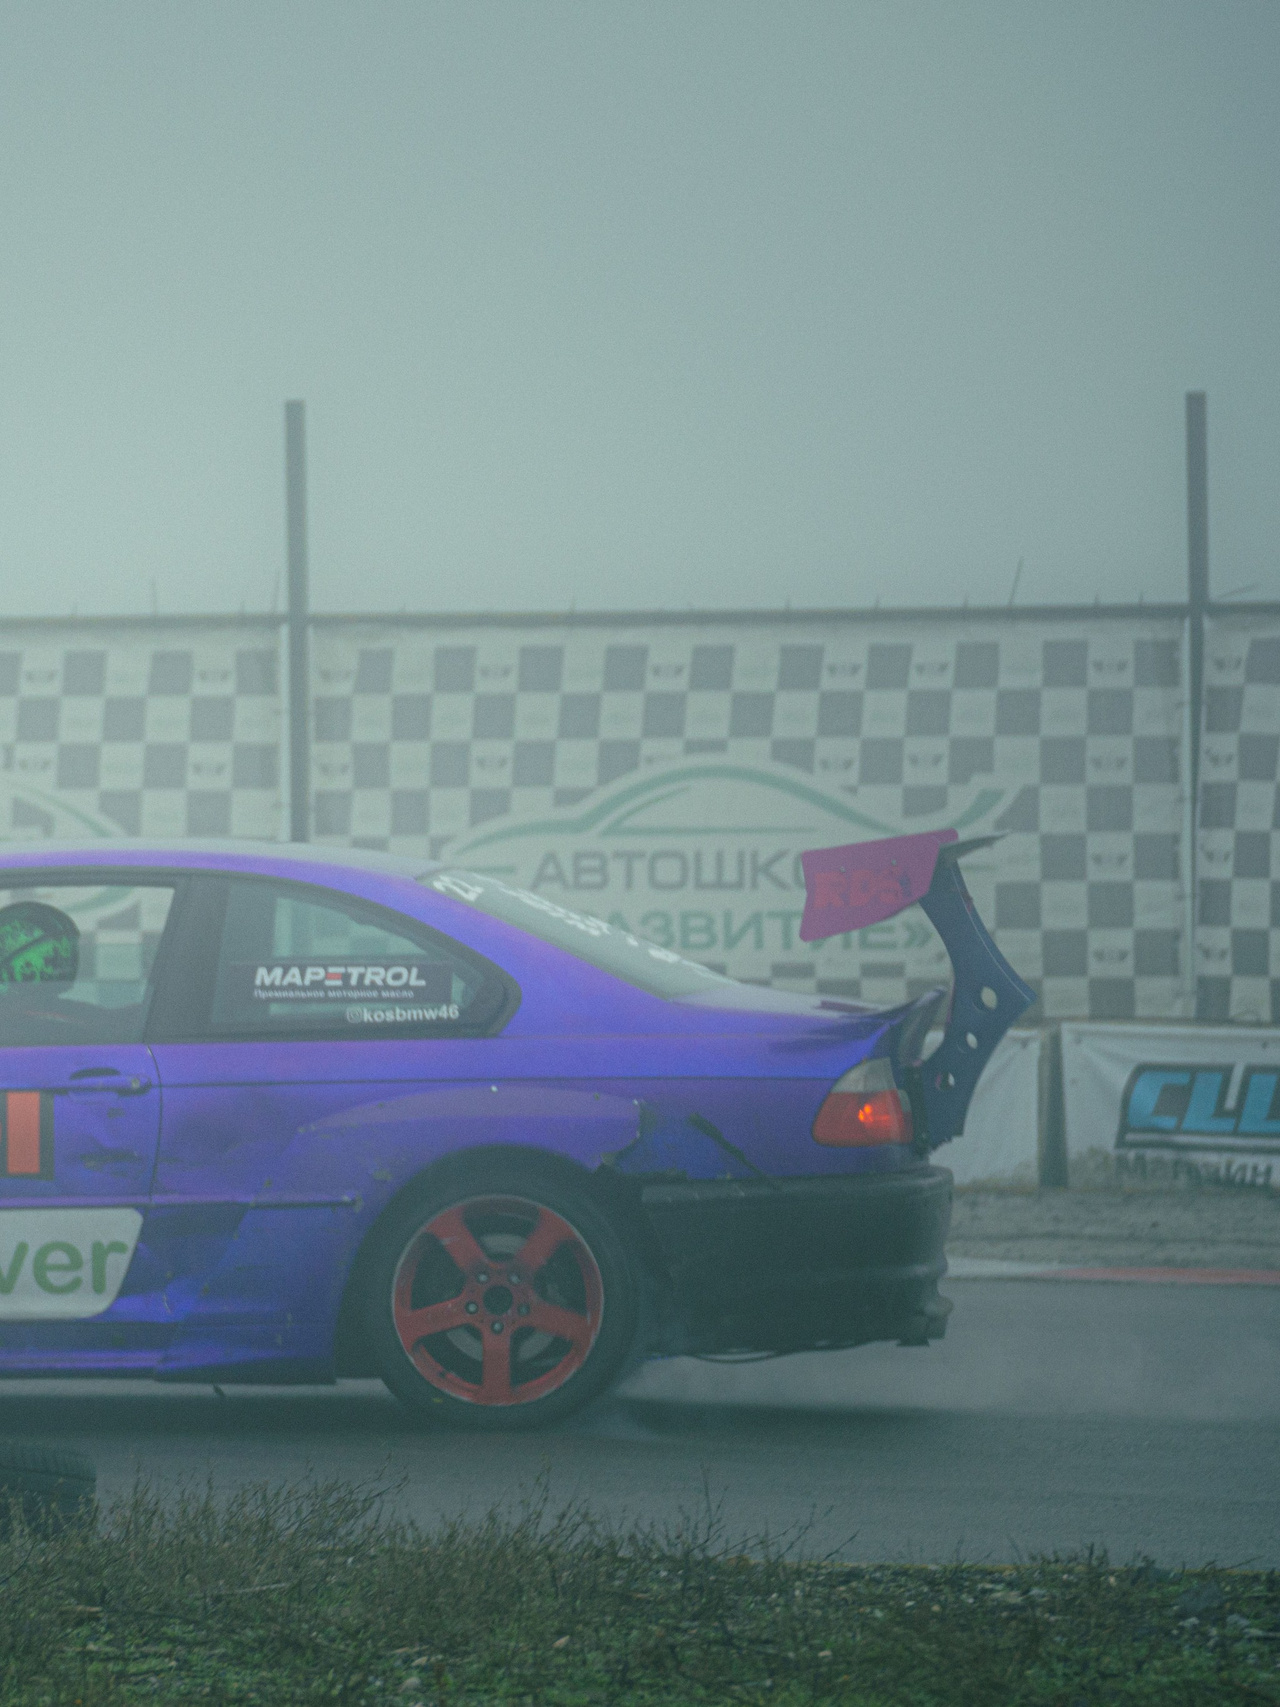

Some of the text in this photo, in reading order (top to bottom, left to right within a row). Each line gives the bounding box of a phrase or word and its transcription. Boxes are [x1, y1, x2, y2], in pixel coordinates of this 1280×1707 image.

[529, 848, 807, 893] АВТОШК
[254, 966, 426, 987] MAPETROL
[381, 989, 415, 999] масло
